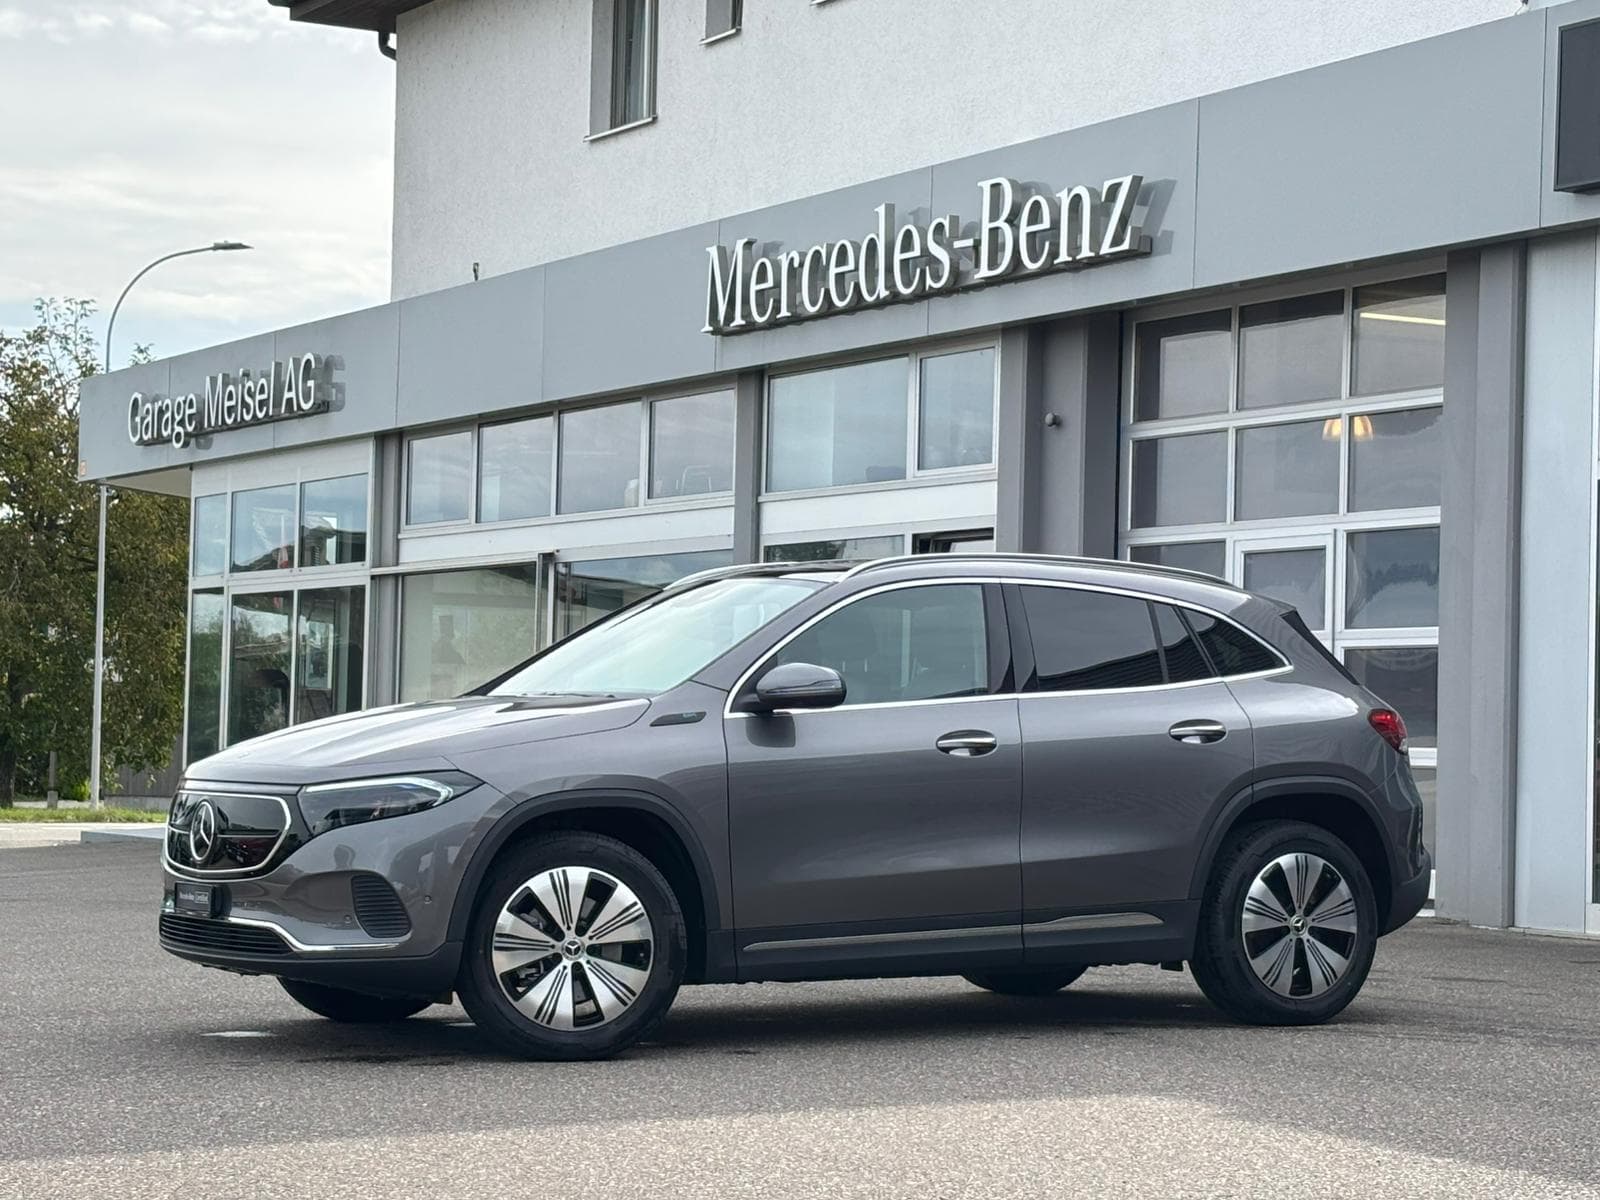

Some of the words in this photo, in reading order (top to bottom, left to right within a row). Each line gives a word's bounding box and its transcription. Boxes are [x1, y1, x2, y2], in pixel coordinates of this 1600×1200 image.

[701, 174, 1142, 333] Mercedes-Benz
[128, 392, 197, 449] Garage
[204, 361, 275, 428] Meisel
[281, 352, 316, 414] AG
